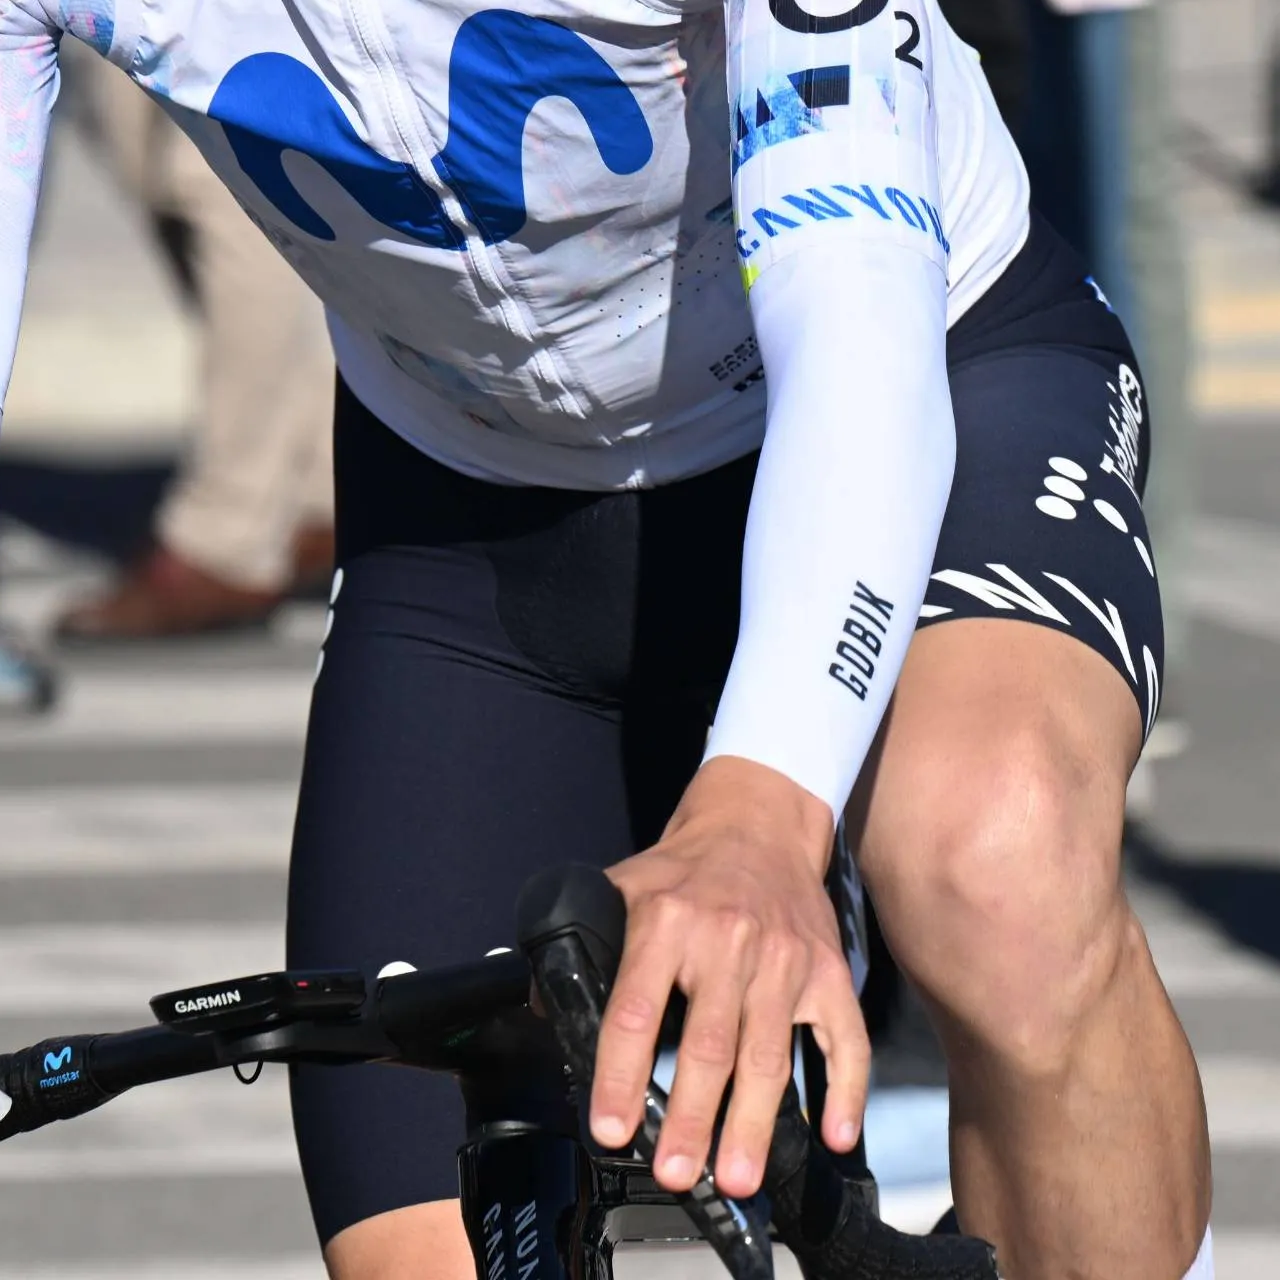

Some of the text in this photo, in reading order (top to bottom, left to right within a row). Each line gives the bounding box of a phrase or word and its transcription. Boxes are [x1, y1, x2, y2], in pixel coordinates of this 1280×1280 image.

[736, 185, 950, 258] CANYON
[829, 580, 894, 701] GOBIK
[174, 989, 241, 1014] GARMIN
